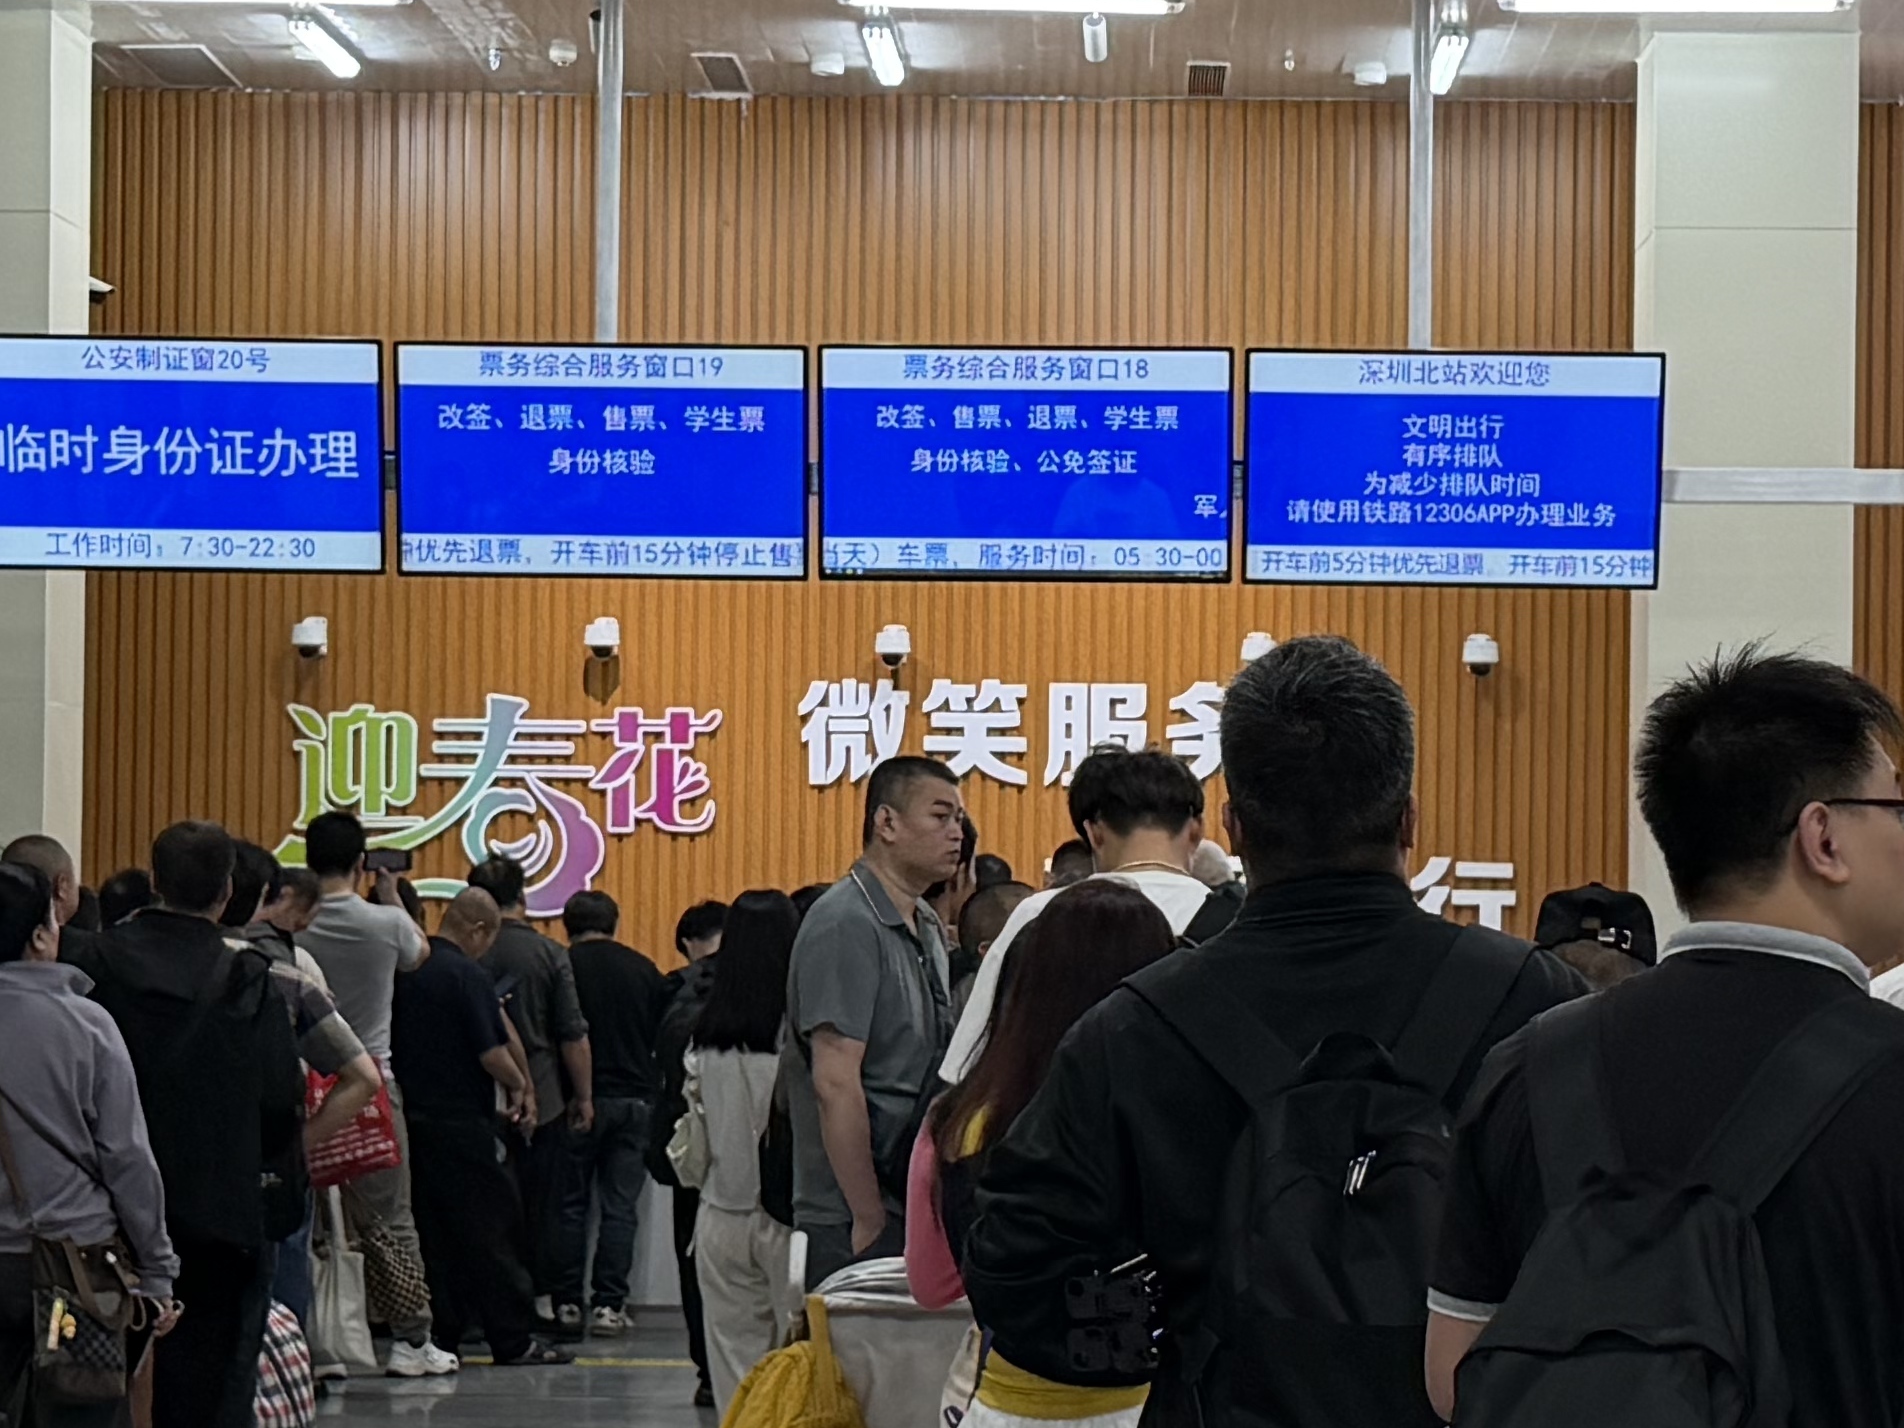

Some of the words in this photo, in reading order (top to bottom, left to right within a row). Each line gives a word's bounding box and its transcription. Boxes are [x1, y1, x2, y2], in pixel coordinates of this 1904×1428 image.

[82, 345, 270, 373] 公安制证窗20号
[479, 350, 723, 378] 票务综合服务窗口19
[903, 353, 1149, 382] 票务综合服务窗口18
[1359, 359, 1551, 387] 深圳北站欢迎您
[437, 403, 766, 432] 改签、退票、售票、学生票
[875, 404, 1180, 431] 改签、售票、退票、学生票
[1401, 414, 1505, 440] 文明出行
[548, 447, 656, 475] 身份核验
[910, 447, 1138, 475] 身份核验、公免签证
[1401, 443, 1504, 469] 有序排队
[1362, 471, 1541, 498] 为减少排队时间
[1193, 493, 1228, 520] 军
[1286, 499, 1617, 529] 请使用铁路12306APP办理业务
[402, 537, 803, 568] 优先退票，开车前15分钟停止售
[797, 678, 1224, 786] 微笑服务
[274, 693, 723, 917] 迎春花
[1409, 856, 1517, 930] 行
